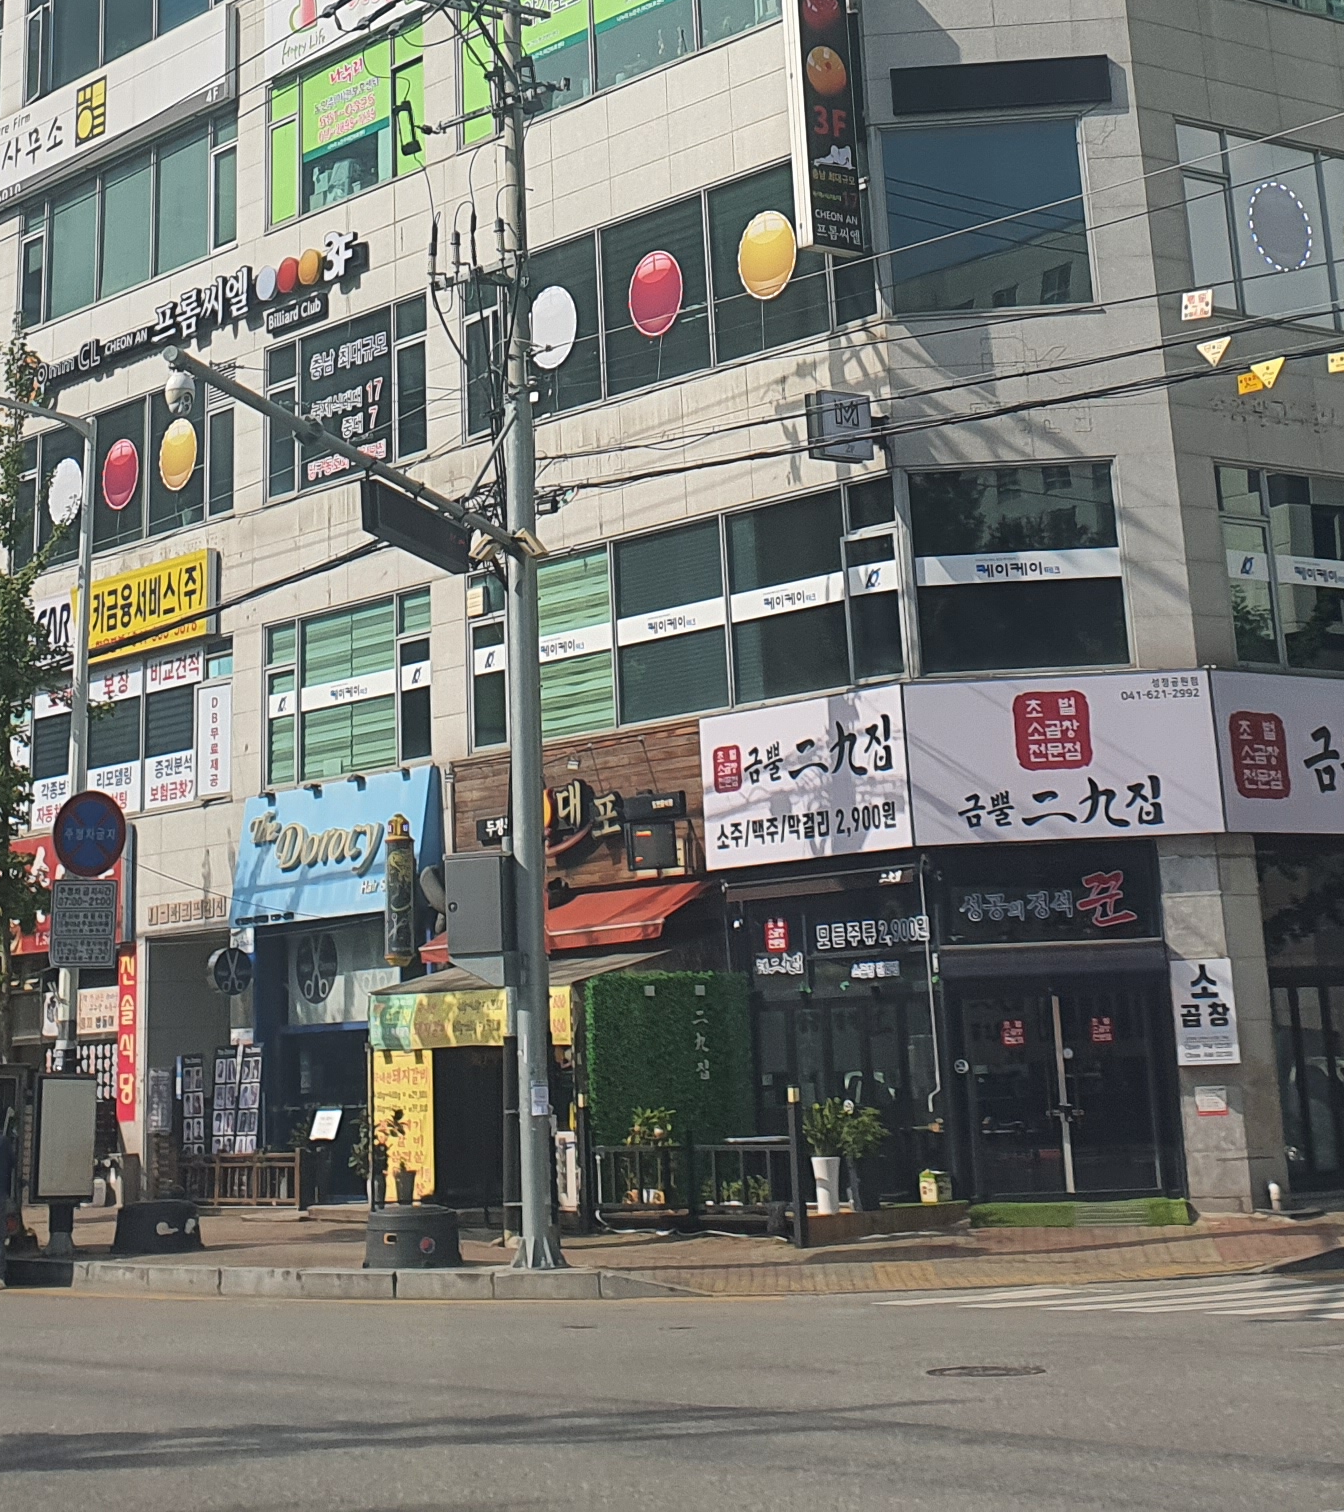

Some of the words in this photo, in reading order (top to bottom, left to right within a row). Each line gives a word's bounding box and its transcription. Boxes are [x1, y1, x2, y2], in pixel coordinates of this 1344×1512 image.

[12, 111, 32, 131] Firm
[813, 105, 847, 138] 3F
[814, 208, 843, 225] CHEON
[845, 212, 858, 226] AN
[323, 231, 357, 282] 3F
[267, 303, 299, 330] Billiard
[300, 297, 322, 321] Club
[104, 332, 134, 355] CHEON
[134, 328, 149, 344] AN
[308, 349, 336, 381] 충남
[337, 331, 389, 369] 최대규모
[365, 376, 384, 405] 17
[102, 669, 130, 697] 보장
[149, 651, 201, 686] 비교견적
[1120, 688, 1201, 701] 041-621-2992
[1027, 720, 1080, 741] 소곱창
[1028, 741, 1083, 763] 전문점
[1241, 743, 1279, 766] 소곱창
[1242, 769, 1283, 791] 전문점
[716, 810, 831, 850] 소주/맥주/막걸리
[835, 800, 898, 836] 2,900원
[815, 920, 877, 950] 모든주류
[876, 914, 931, 947] 2,900원
[1190, 963, 1220, 1000] 소
[1180, 1001, 1231, 1030] 곱창
[119, 955, 135, 1106] 진솔식당
